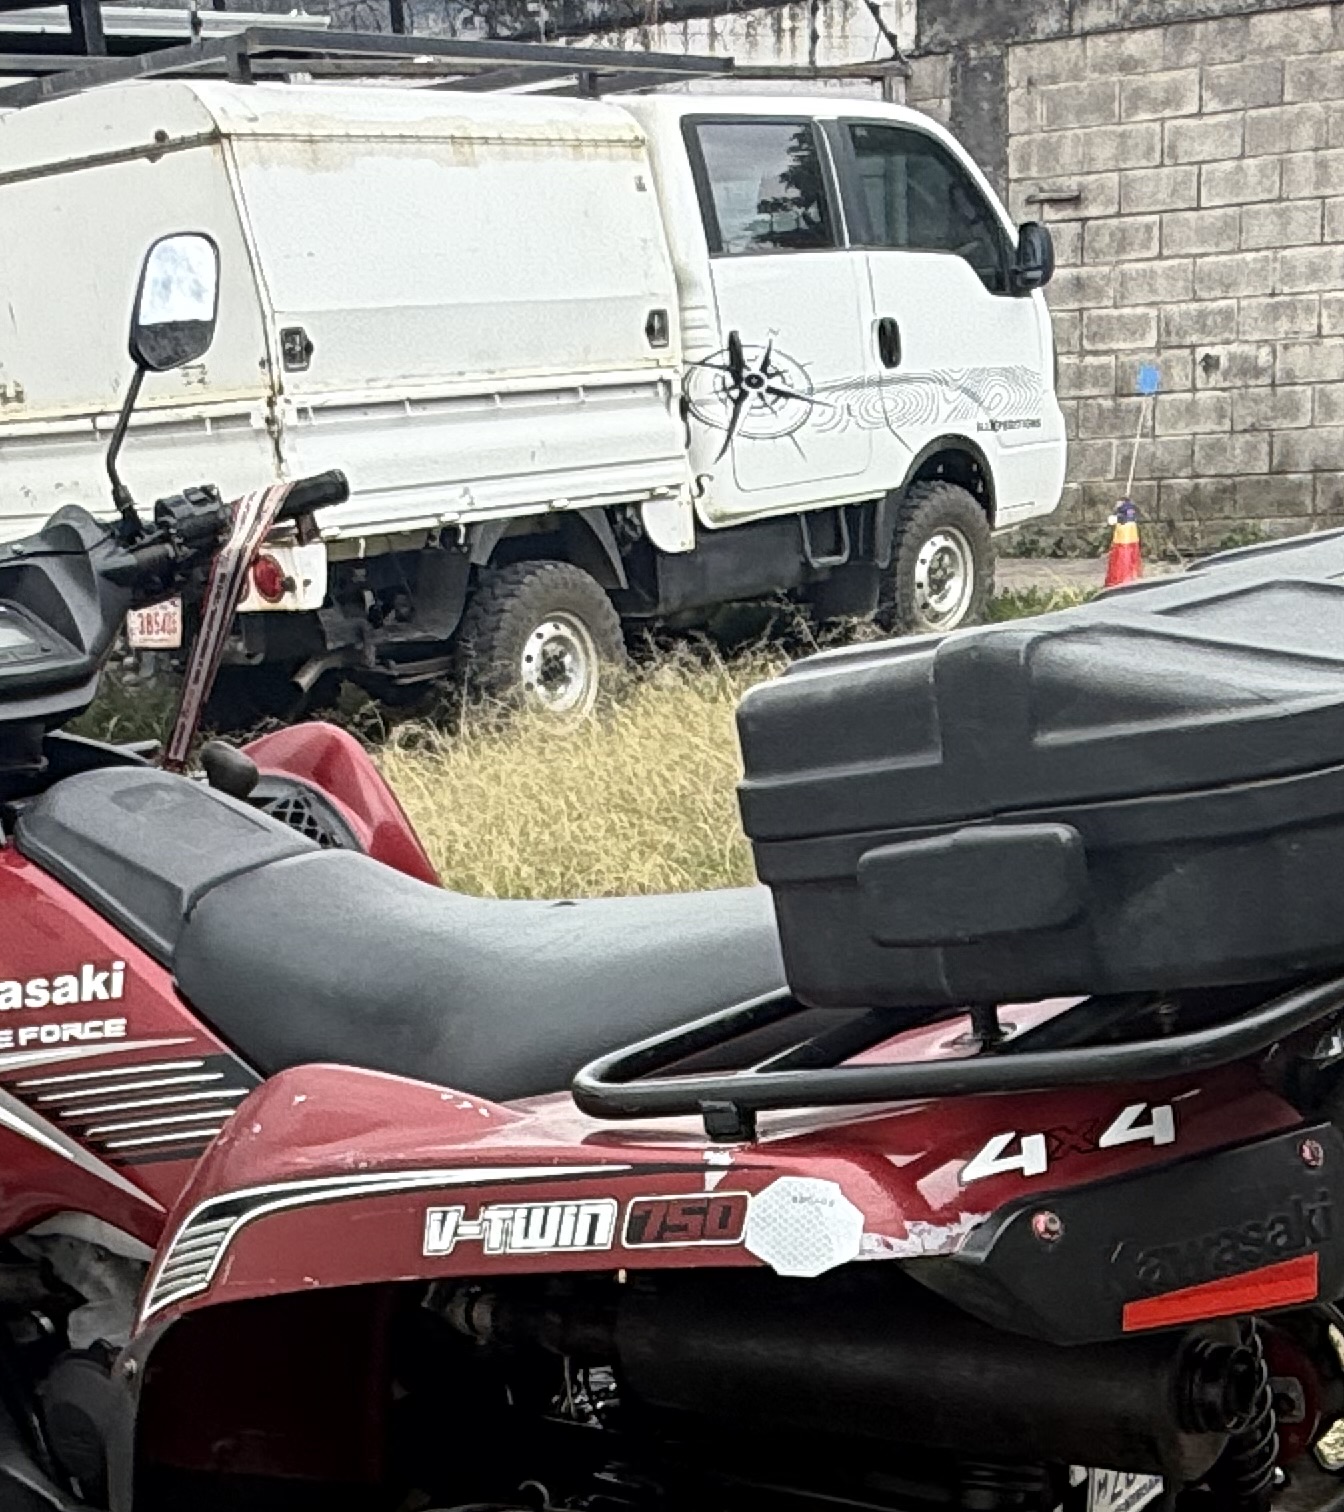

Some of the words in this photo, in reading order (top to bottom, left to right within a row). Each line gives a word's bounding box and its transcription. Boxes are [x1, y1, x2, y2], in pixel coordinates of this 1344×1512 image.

[19, 1018, 127, 1046] FORCE
[424, 1200, 617, 1255] V-TWIN
[632, 1198, 743, 1244] 750
[1110, 1188, 1333, 1287] Kawasaki
